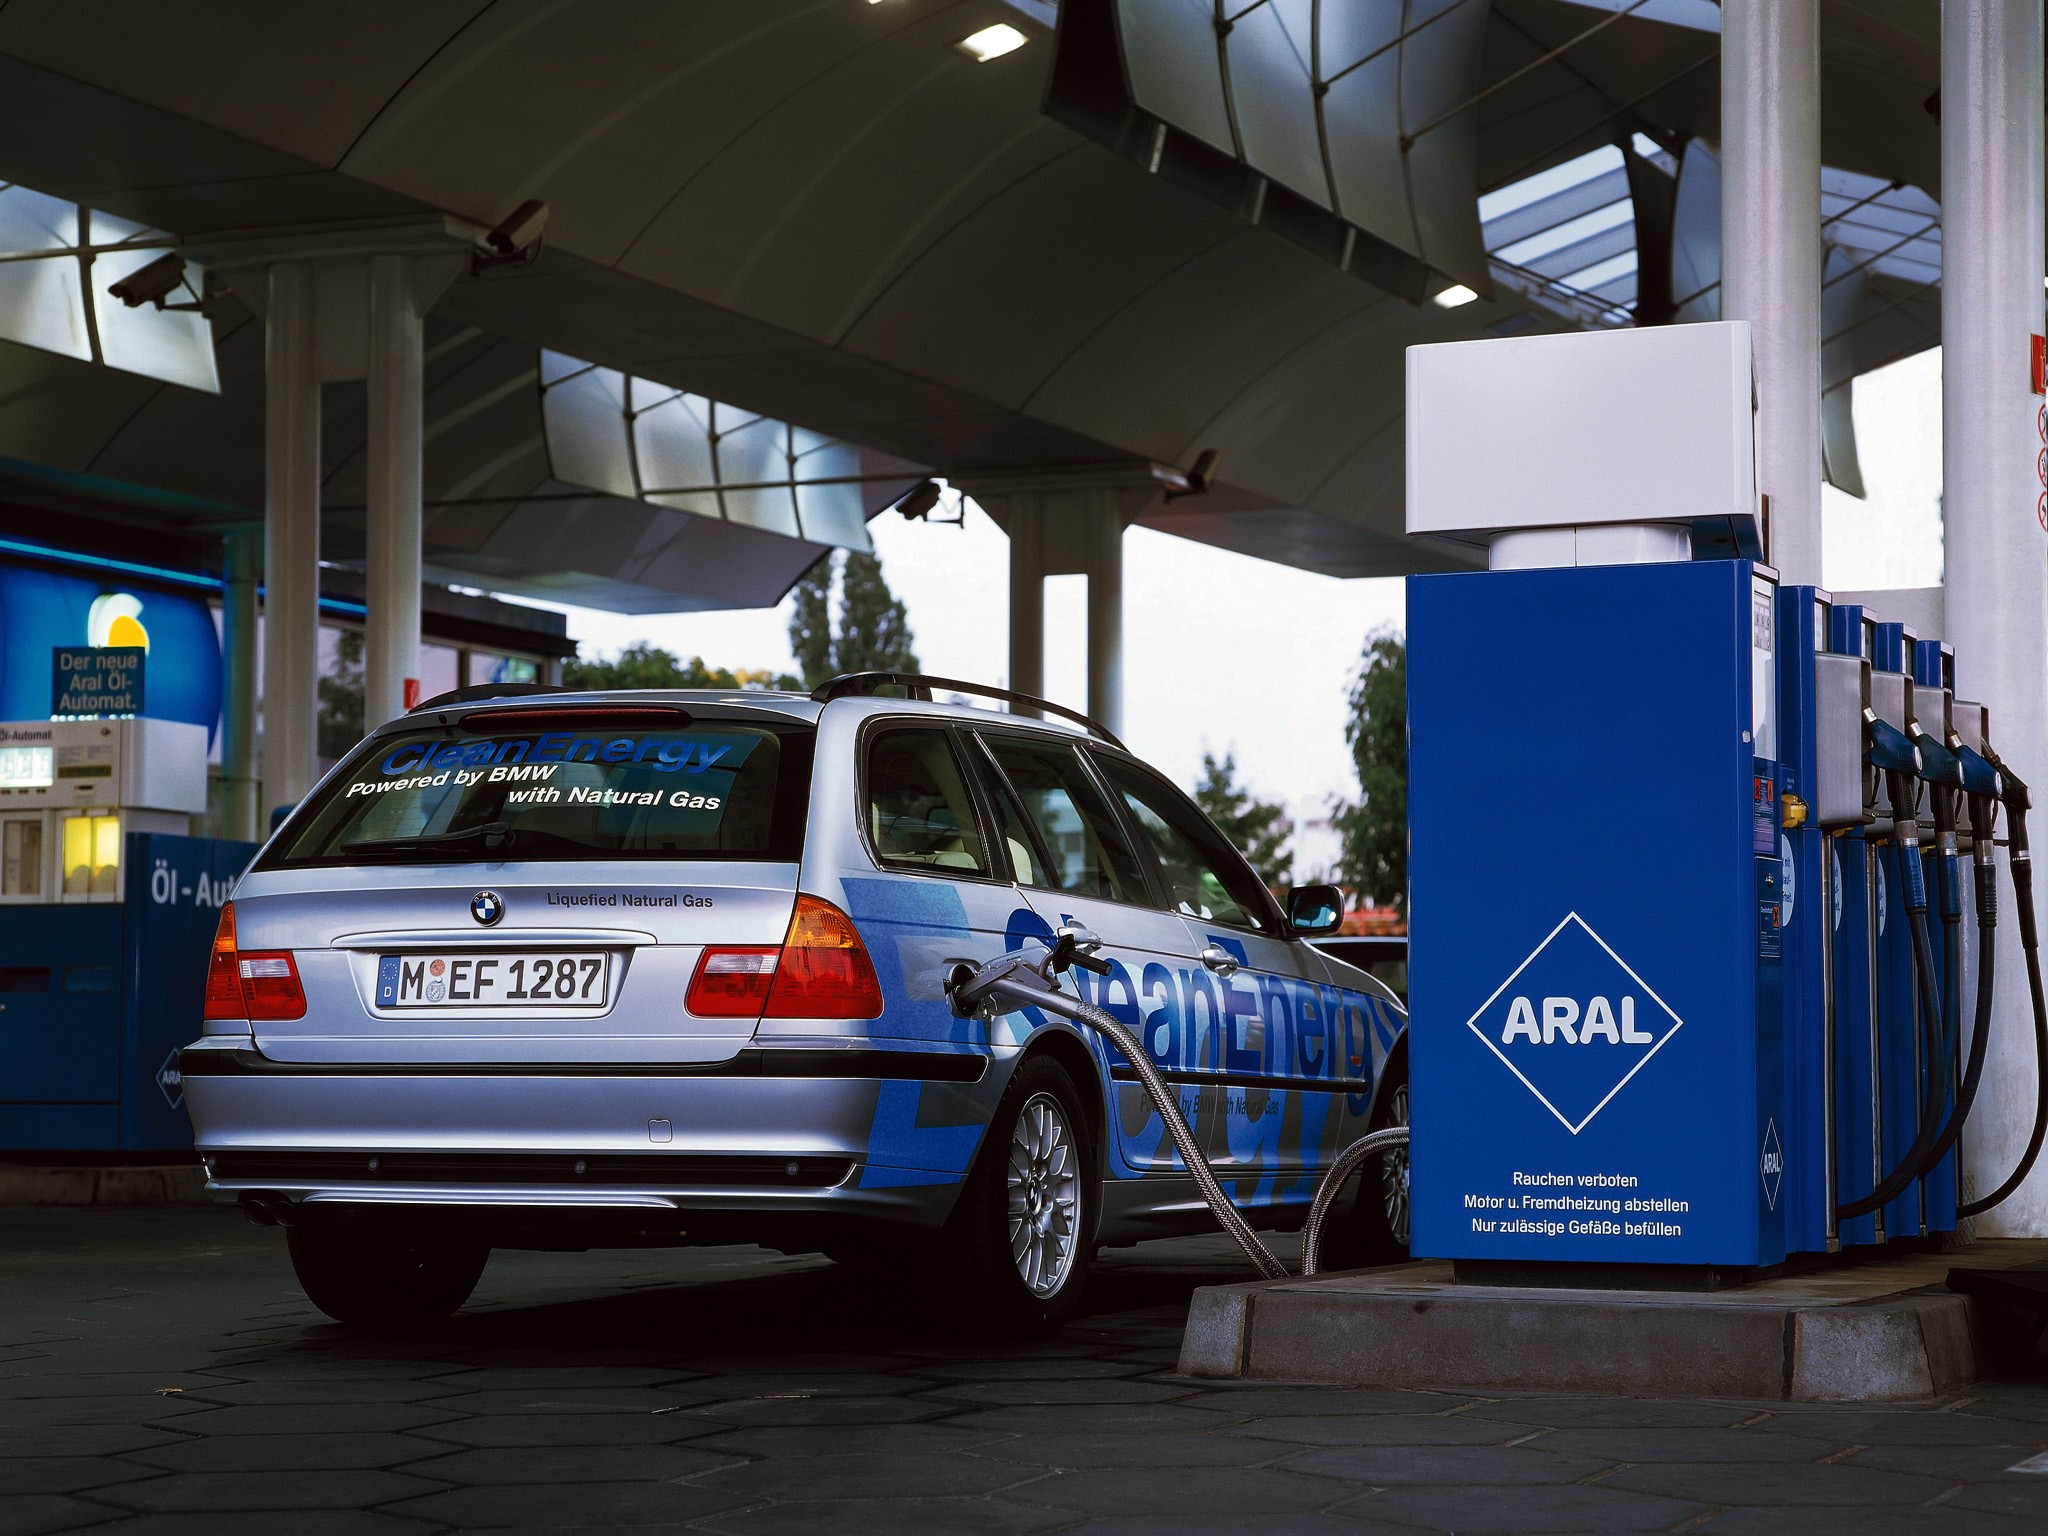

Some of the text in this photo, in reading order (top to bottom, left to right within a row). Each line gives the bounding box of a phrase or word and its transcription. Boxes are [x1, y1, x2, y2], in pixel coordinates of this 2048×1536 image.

[60, 653, 138, 671] Der neue
[70, 669, 132, 690] Aral Öl-
[59, 693, 137, 711] Automat.
[380, 731, 732, 776] CleanEnergy
[346, 765, 559, 799] Powered by BMW
[507, 786, 722, 811] with Natural Gas
[151, 859, 178, 905] Öl
[547, 892, 714, 908] Liquefied Natural Gas
[400, 959, 602, 1000] M EF 1287
[384, 986, 392, 998] D
[1501, 996, 1653, 1045] ARAL
[162, 1070, 181, 1085] ARA
[1181, 1094, 1193, 1117] by
[1193, 1095, 1217, 1115] BMW
[1216, 1096, 1234, 1116] with
[1236, 1096, 1264, 1116] Natural
[1264, 1097, 1280, 1116] Gas
[1763, 1152, 1780, 1175] ARAL
[1513, 1172, 1638, 1188] Rauchen verboten
[1464, 1194, 1689, 1214] Motor u. Fremdheizung abstellen
[1472, 1218, 1682, 1236] Nur zulässige Gefäße befüllen
